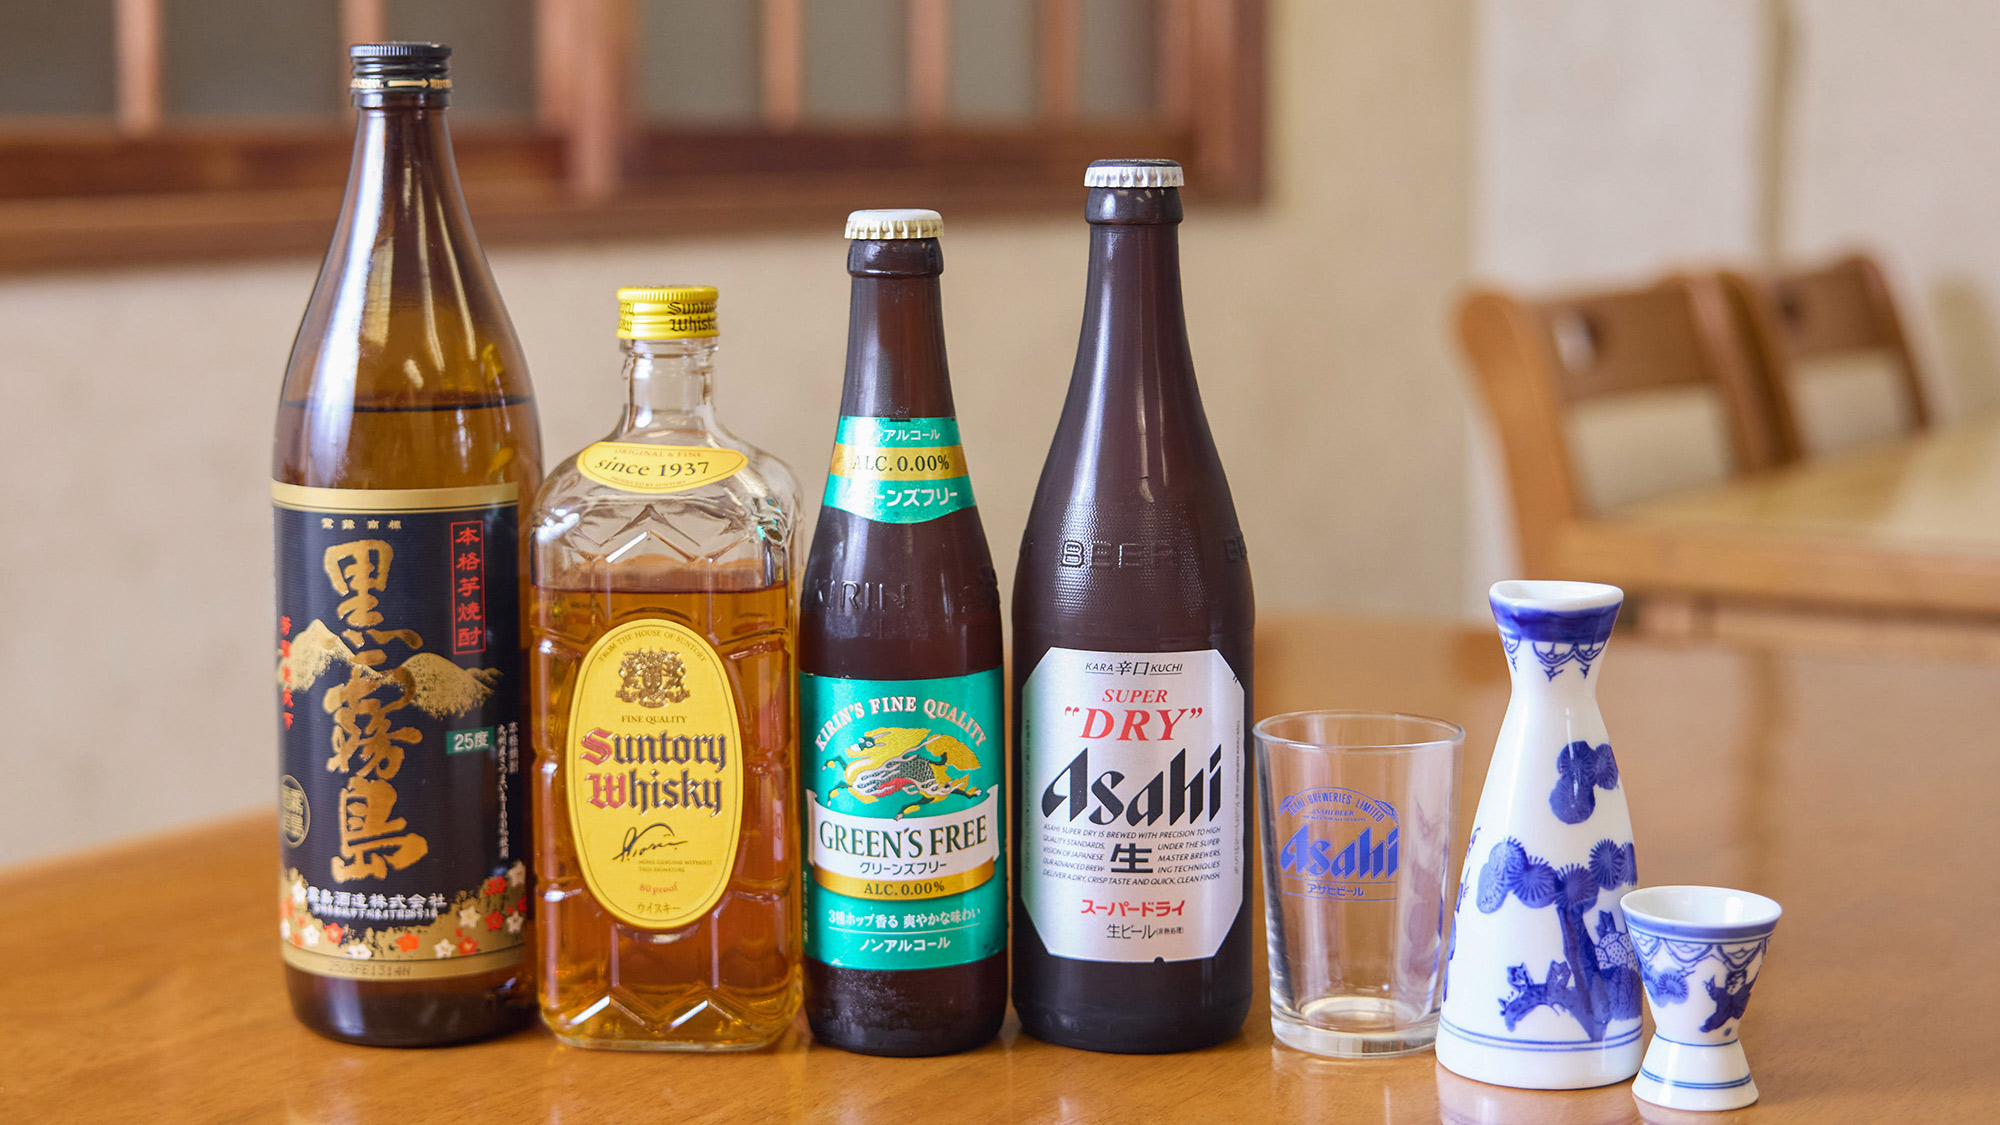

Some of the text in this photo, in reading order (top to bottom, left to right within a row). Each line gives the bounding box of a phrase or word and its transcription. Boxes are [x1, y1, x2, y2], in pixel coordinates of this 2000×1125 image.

[667, 301, 717, 315] Sunto
[878, 429, 941, 442] アルコール
[615, 448, 663, 458] ORIGINAL
[594, 456, 710, 478] since 1937
[896, 454, 950, 472] 0.00%
[874, 487, 958, 507] ーンズフリー
[455, 526, 483, 648] 本格芋焼酎
[598, 629, 708, 662] FROM THE HOUSE OF SUNTORY
[1085, 660, 1183, 675] KARA 辛口 KUCHI
[1102, 688, 1169, 704] SUPER
[323, 539, 428, 883] 黒霧島
[621, 715, 687, 724] FINE QUALITY
[815, 696, 987, 752] KIRIN'S FINE QUALITY
[454, 731, 490, 751] 25度
[580, 726, 728, 774] Suntory
[584, 768, 724, 817] Whisky
[1041, 744, 1222, 827] Asahi
[1307, 791, 1353, 805] BREWERIES
[1355, 798, 1385, 823] LIMITED
[819, 814, 988, 859] GREEN'S FREE
[1043, 823, 1221, 839] ASAHI SUPER DRY IS BREWED WITH PRECISION TO HIGH
[1043, 834, 1066, 843] QUALITY
[1157, 842, 1184, 851] UNDER
[1185, 840, 1199, 849] THE
[1279, 823, 1400, 880] Asahi
[1043, 846, 1061, 855] VISION
[1062, 849, 1071, 857] OF
[1071, 850, 1105, 861] JAPANESE
[1157, 853, 1190, 862] MASTER
[1110, 842, 1153, 873] 生
[859, 861, 947, 876] グリーンズフリー
[1042, 857, 1054, 865] OUR
[1054, 860, 1085, 871] ADVANCED
[1157, 865, 1173, 873] ING
[1174, 860, 1221, 873] TECHNIQUES
[1042, 868, 1067, 878] DELIVER
[1087, 875, 1108, 884] CRISP
[1108, 877, 1132, 886] TASTE
[1131, 878, 1149, 886] AND
[1176, 875, 1200, 884] CLEAN
[639, 881, 678, 896] 80 proof
[863, 880, 945, 896] ALC. 0.00%
[1306, 883, 1365, 897] アサヒビール
[637, 901, 681, 914] ウイスキー
[1080, 899, 1186, 918] スーパードライ
[828, 907, 981, 929] 3種ホップ香る 爽やかな味わい
[859, 936, 951, 953] ノンアルコール
